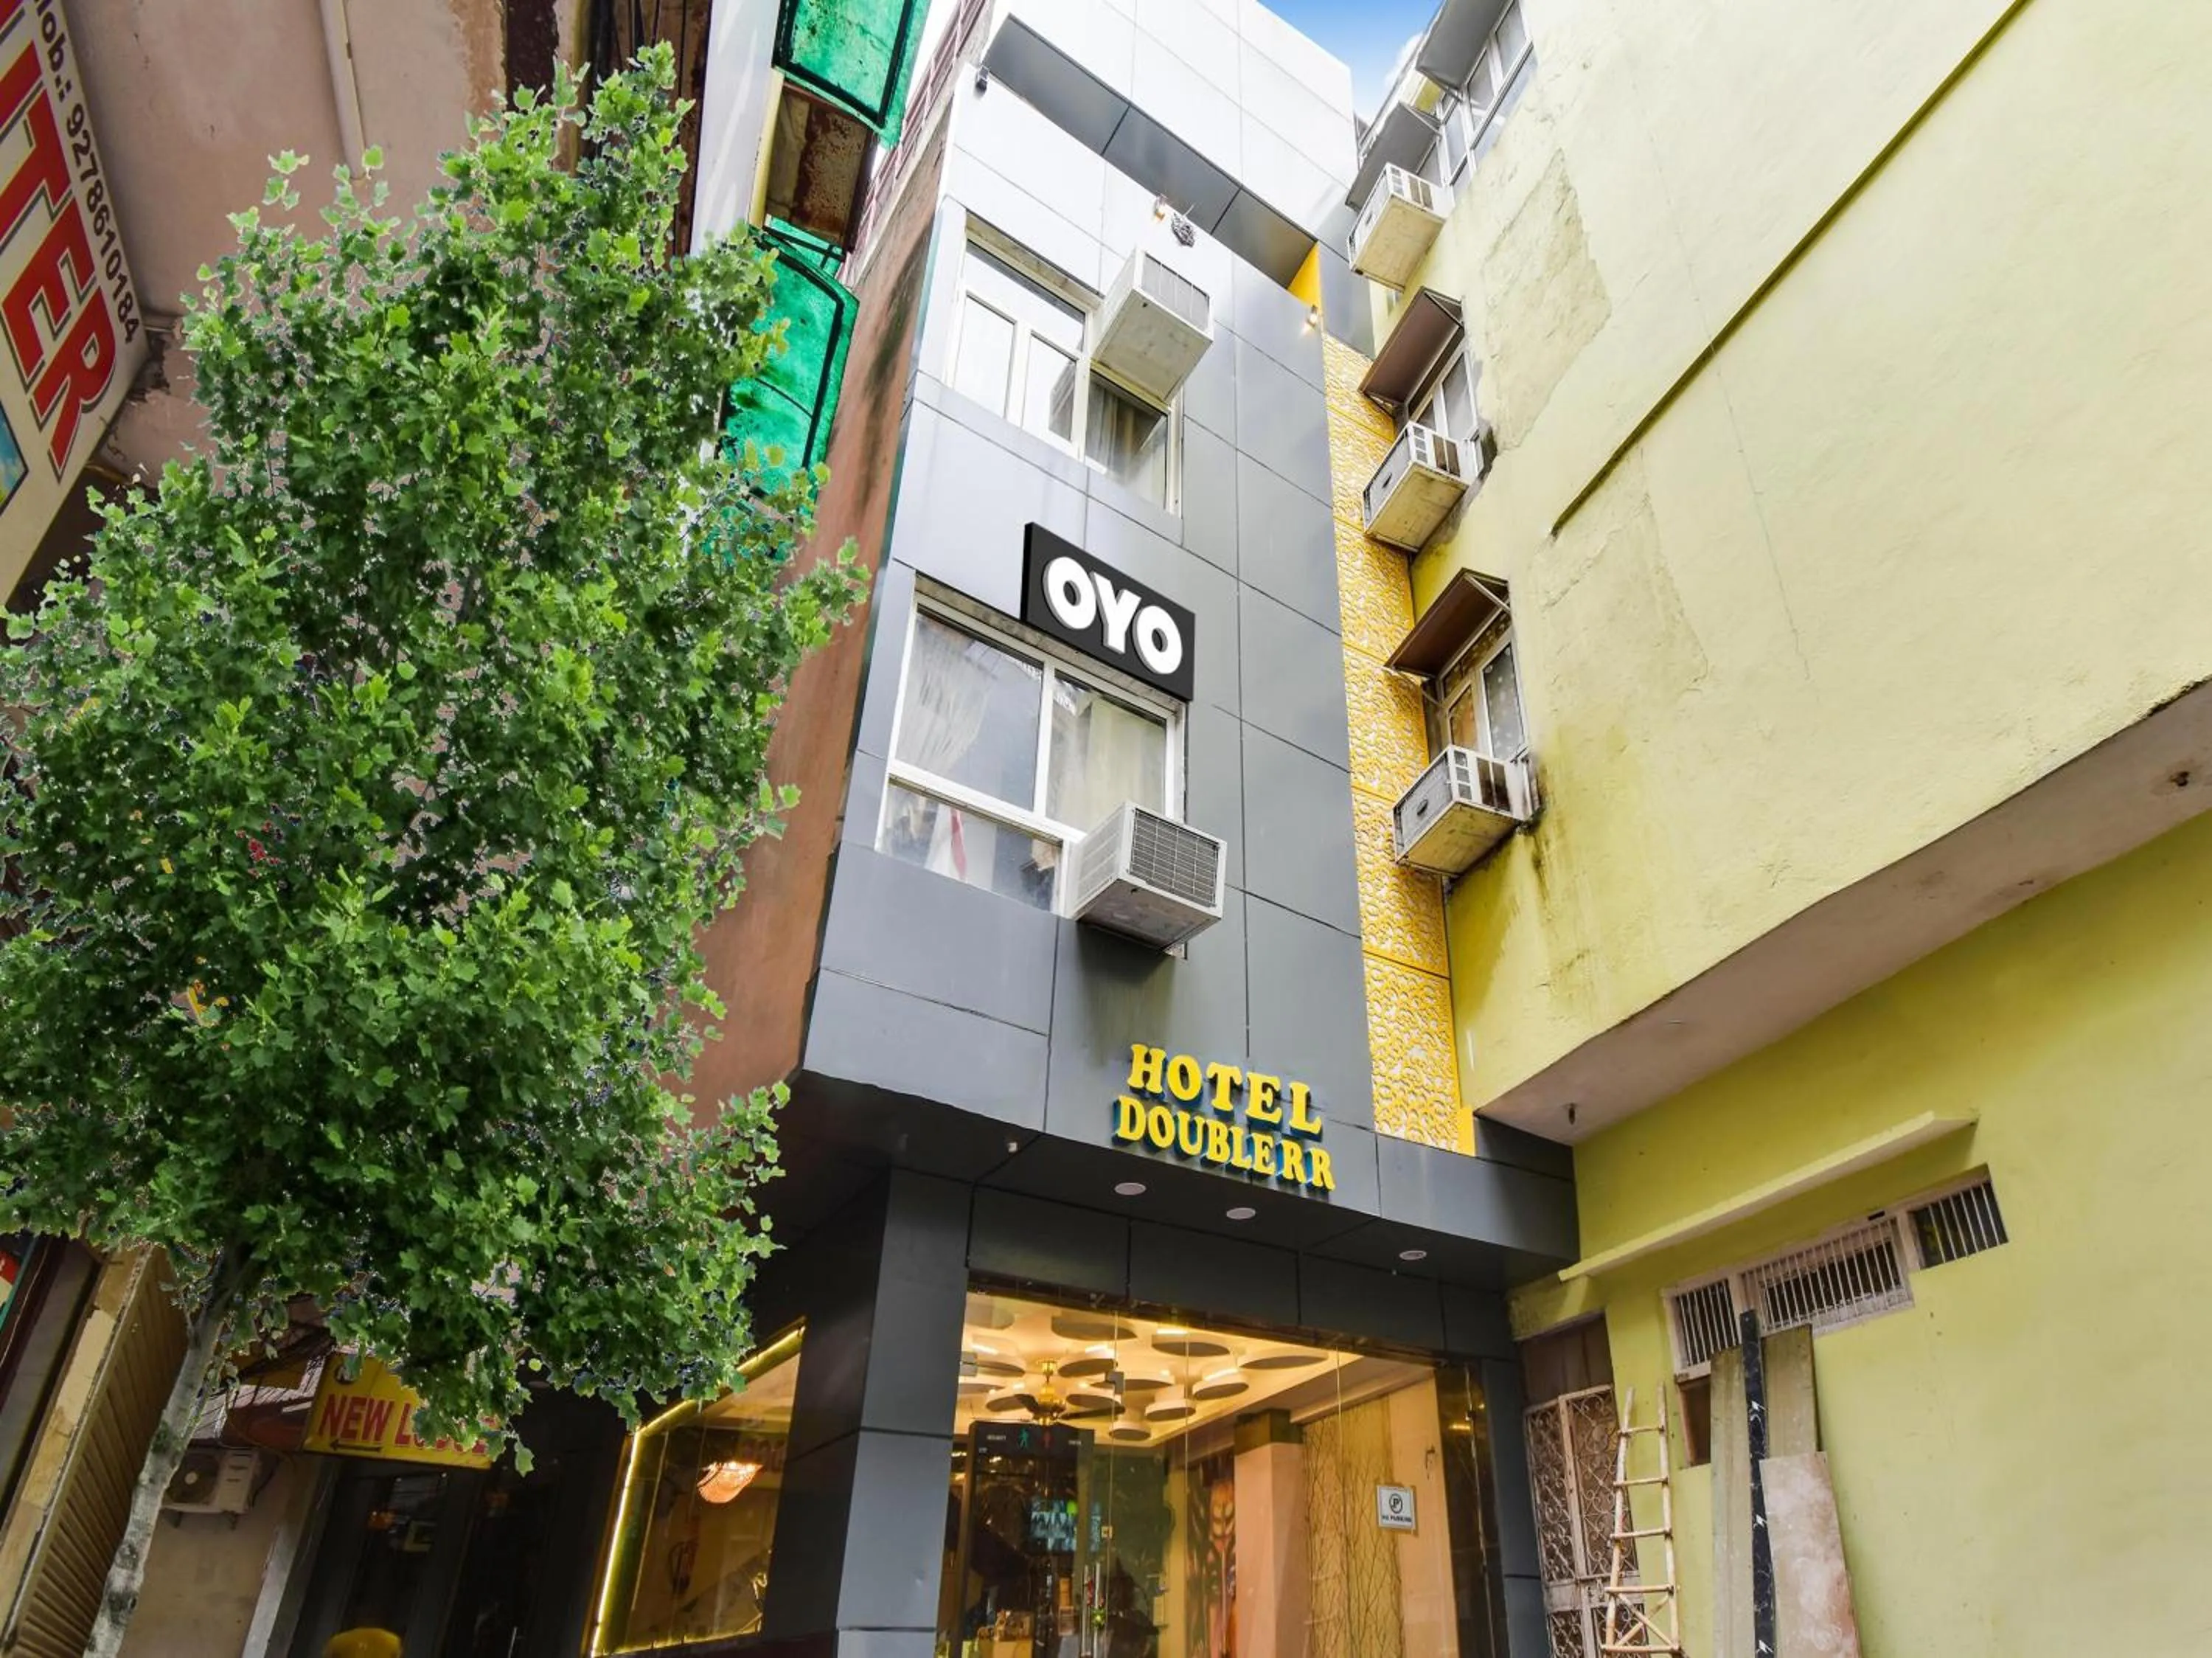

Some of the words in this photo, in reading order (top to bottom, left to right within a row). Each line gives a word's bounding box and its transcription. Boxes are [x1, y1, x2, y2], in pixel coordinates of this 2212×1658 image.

[34, 0, 72, 103] ob.:
[66, 103, 139, 344] 9278610184
[1042, 556, 1183, 675] OYO
[1127, 1044, 1323, 1137] HOTEL
[319, 1392, 395, 1442] NEW
